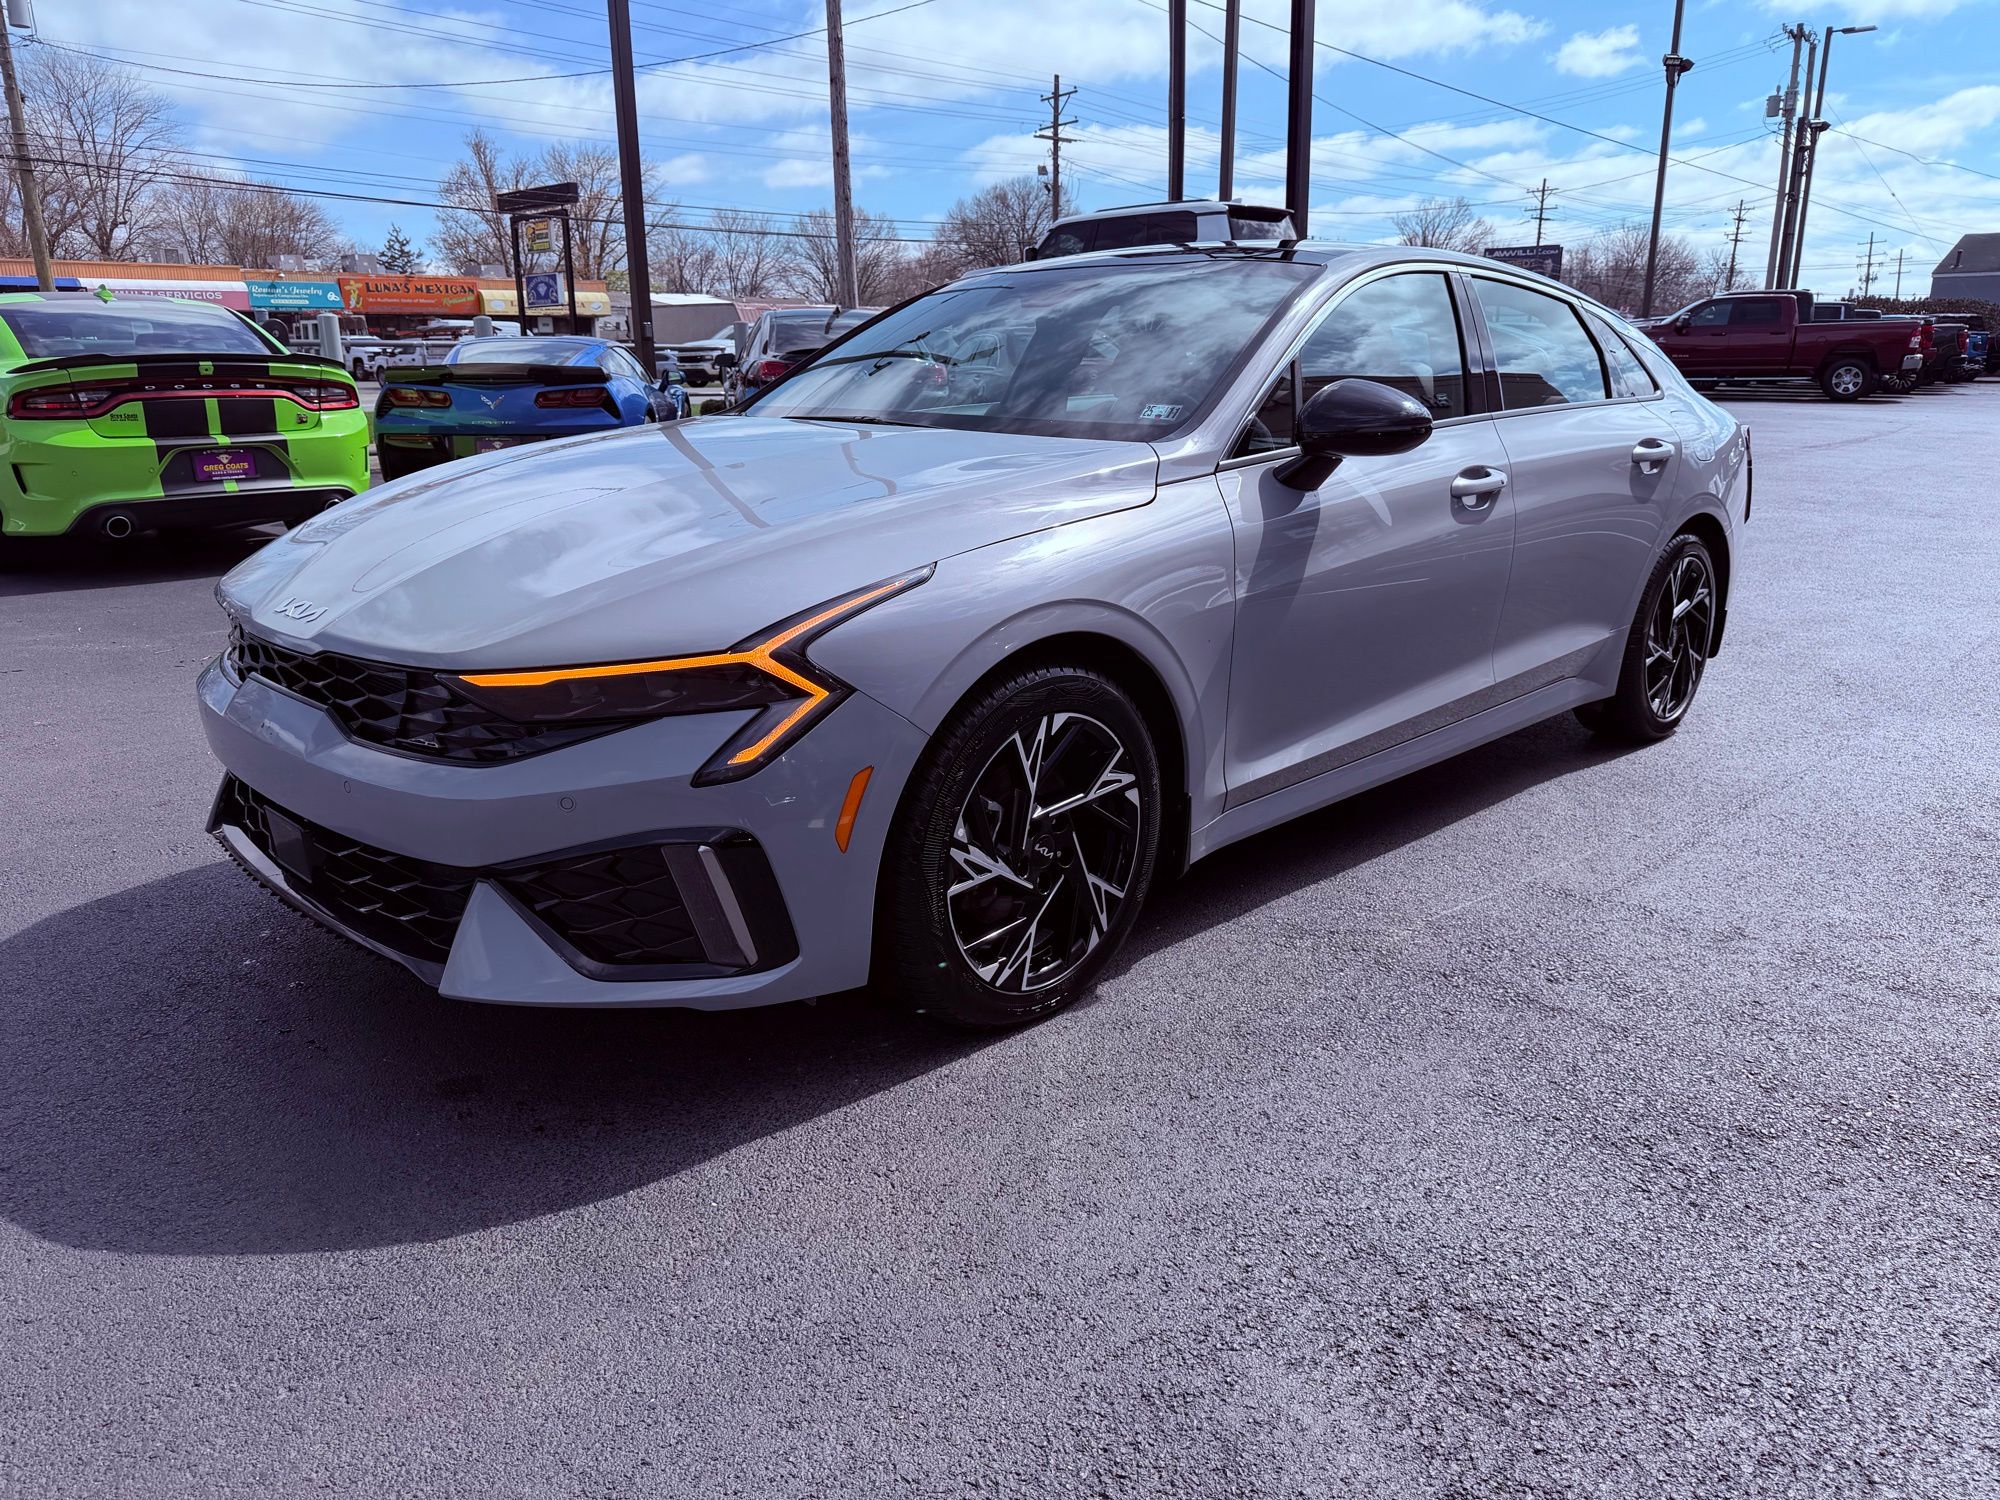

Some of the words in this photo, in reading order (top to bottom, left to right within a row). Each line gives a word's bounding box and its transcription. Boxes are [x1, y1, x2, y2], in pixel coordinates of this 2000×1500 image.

[365, 281, 411, 293] LUNA'S
[414, 282, 475, 295] MEXICAN
[1143, 405, 1157, 417] 25
[203, 464, 224, 472] GREG
[225, 462, 249, 470] COATS
